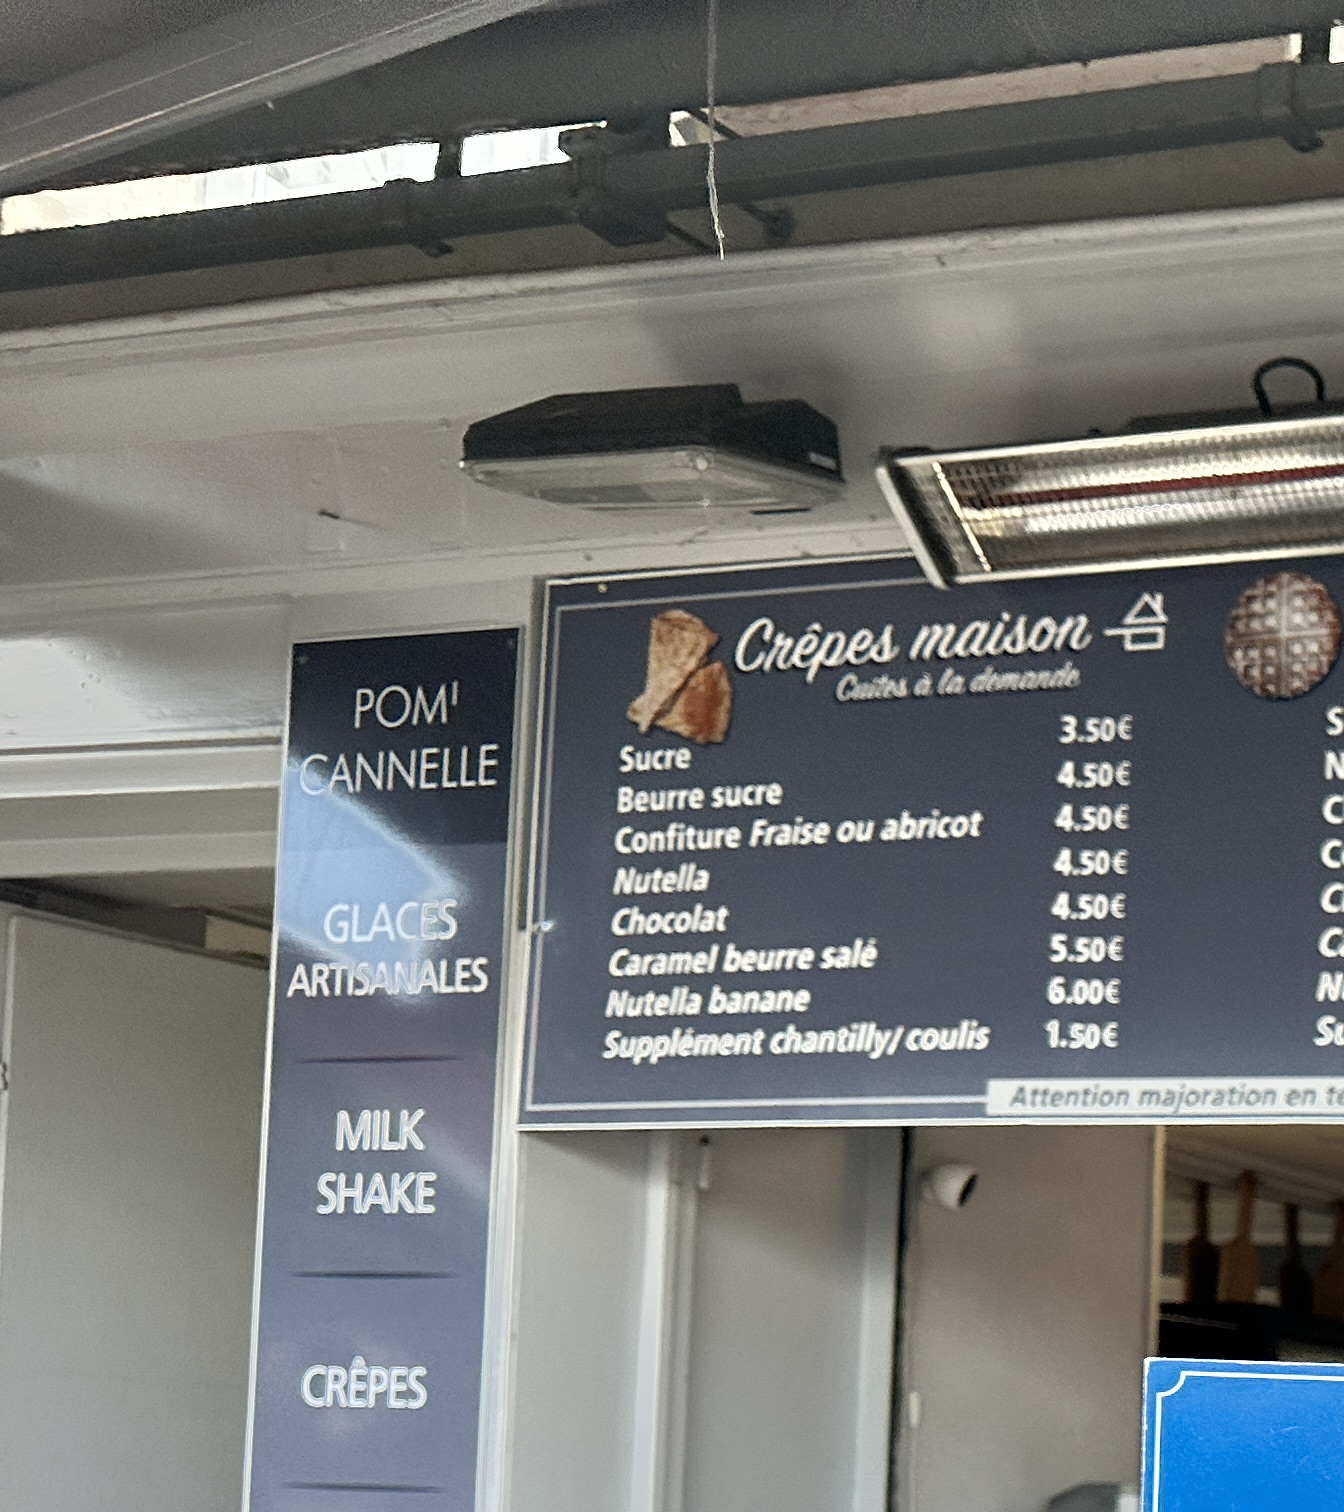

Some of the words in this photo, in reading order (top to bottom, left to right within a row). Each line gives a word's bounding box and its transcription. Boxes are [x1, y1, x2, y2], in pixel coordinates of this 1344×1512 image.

[736, 618, 899, 682] Crêpes
[910, 612, 1092, 659] maison
[836, 673, 907, 700] Cuites
[914, 673, 932, 695] à
[938, 668, 965, 694] la
[970, 661, 1079, 692] demande
[1060, 715, 1131, 743] 3.50€
[299, 744, 498, 794] CANNELLE
[620, 746, 691, 772] Sucre
[1058, 761, 1129, 788] 4.50€
[618, 787, 704, 813] Beurre
[712, 783, 782, 807] sucre
[615, 823, 741, 853] Confiture
[749, 817, 830, 847] Fraise
[837, 820, 874, 842] ou
[880, 809, 983, 840] abricot
[1055, 804, 1128, 831] 4.50€
[1054, 848, 1126, 876] 4.50€
[613, 863, 709, 894] Nutella
[323, 900, 458, 944] GLACES
[612, 903, 728, 935] Chocolat
[1052, 893, 1125, 920] 4.50€
[609, 944, 719, 976] Caramel
[723, 943, 814, 972] beurre
[820, 938, 877, 969] salé
[1050, 934, 1122, 962] 5.50€
[287, 957, 488, 998] ARTISANALES
[1048, 977, 1119, 1004] 6.00€
[605, 986, 702, 1017] Nutella
[708, 986, 810, 1014] banane
[603, 1027, 765, 1064] Supplément
[770, 1020, 990, 1059] chantilly/coulis
[1046, 1020, 1117, 1049] 1.50€
[1009, 1085, 1130, 1109] Attention
[1140, 1082, 1278, 1114] majoration
[1289, 1088, 1316, 1107] en
[336, 1109, 425, 1150] MILK
[317, 1172, 437, 1214] SHAKE
[301, 1356, 427, 1409] CRÊPES
